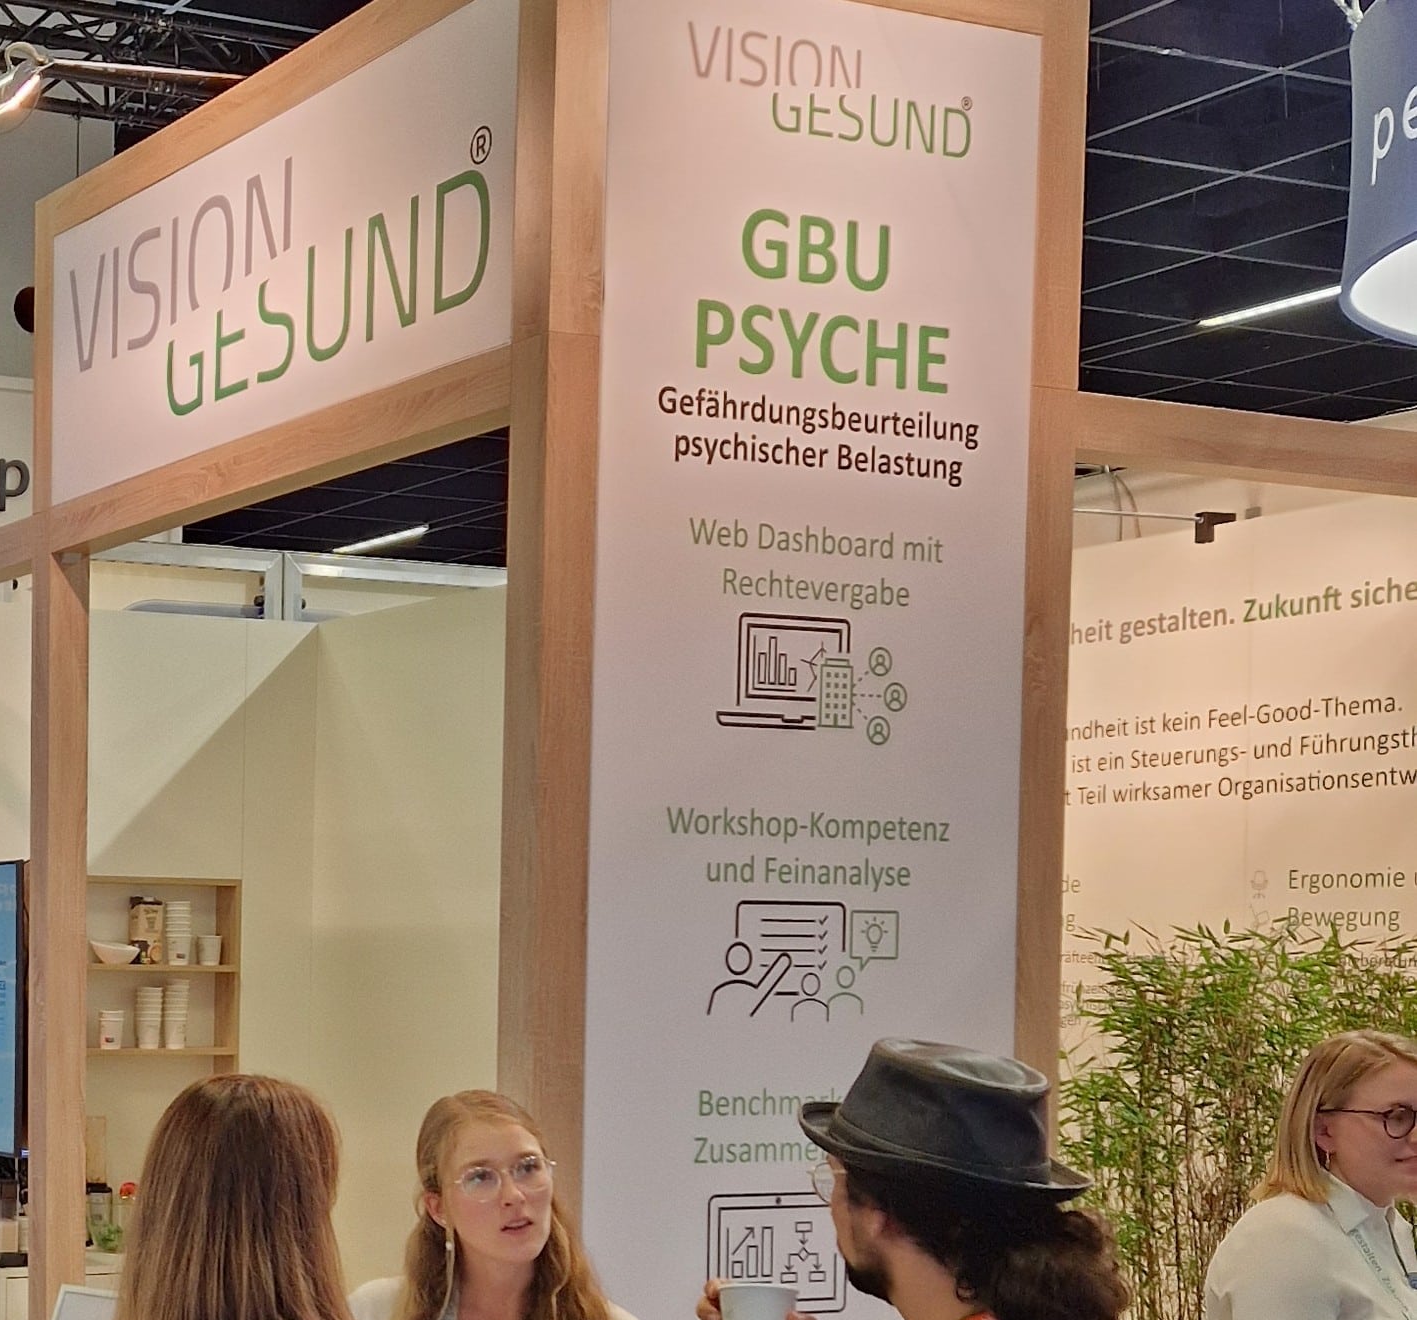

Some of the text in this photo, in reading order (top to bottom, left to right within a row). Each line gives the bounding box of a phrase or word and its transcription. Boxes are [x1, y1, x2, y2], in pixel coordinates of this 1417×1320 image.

[688, 21, 862, 90] VISION
[69, 157, 293, 373] VISION
[742, 207, 891, 292] GBU
[696, 298, 951, 395] PSYCHE
[658, 385, 980, 450] Gefährdungsbeurteilung
[674, 431, 963, 488] psychischer Belastung
[689, 517, 944, 564] Web Dashboard mit
[722, 568, 911, 608] Rechtevergabe
[1119, 606, 1236, 645] gestalten.
[1242, 585, 1343, 624] Zukunft
[1135, 715, 1157, 736] ist
[1162, 712, 1202, 733] kein
[1208, 695, 1403, 729] Feel-Good-Thema.
[1072, 755, 1092, 774] ist
[1097, 753, 1125, 773] ein
[1130, 744, 1247, 770] Steuerungs-
[1253, 736, 1292, 760] und
[1078, 785, 1107, 806] Teil
[1113, 781, 1213, 803] wirksamer
[667, 806, 951, 845] Workshop-Kompetenz
[706, 852, 911, 891] und Feinanalyse
[1288, 867, 1405, 895] Ergonomie
[1287, 906, 1401, 932] Bewegung
[693, 1137, 827, 1164] Zusamme
